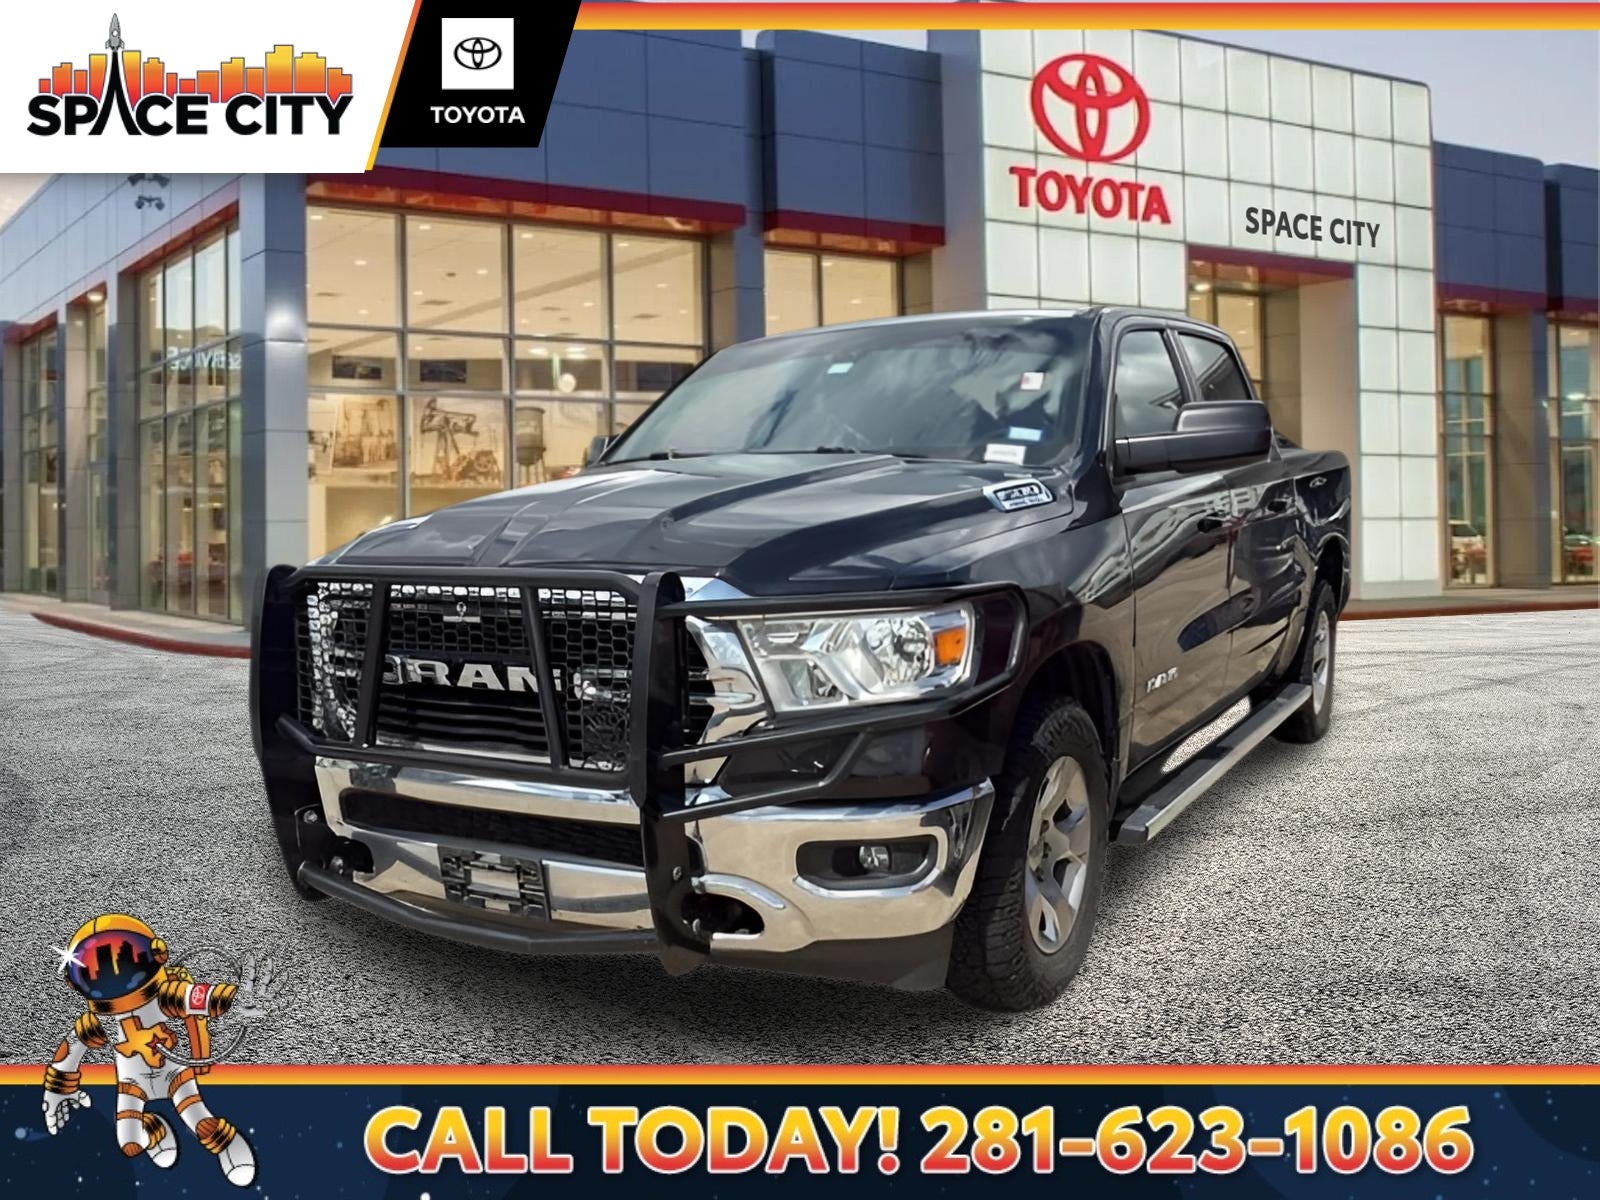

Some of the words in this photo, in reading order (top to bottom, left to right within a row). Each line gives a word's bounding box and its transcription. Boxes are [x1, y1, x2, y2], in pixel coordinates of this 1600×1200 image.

[1009, 166, 1171, 224] TOYOTA
[1245, 207, 1322, 242] SPACE
[1329, 217, 1380, 247] CITY
